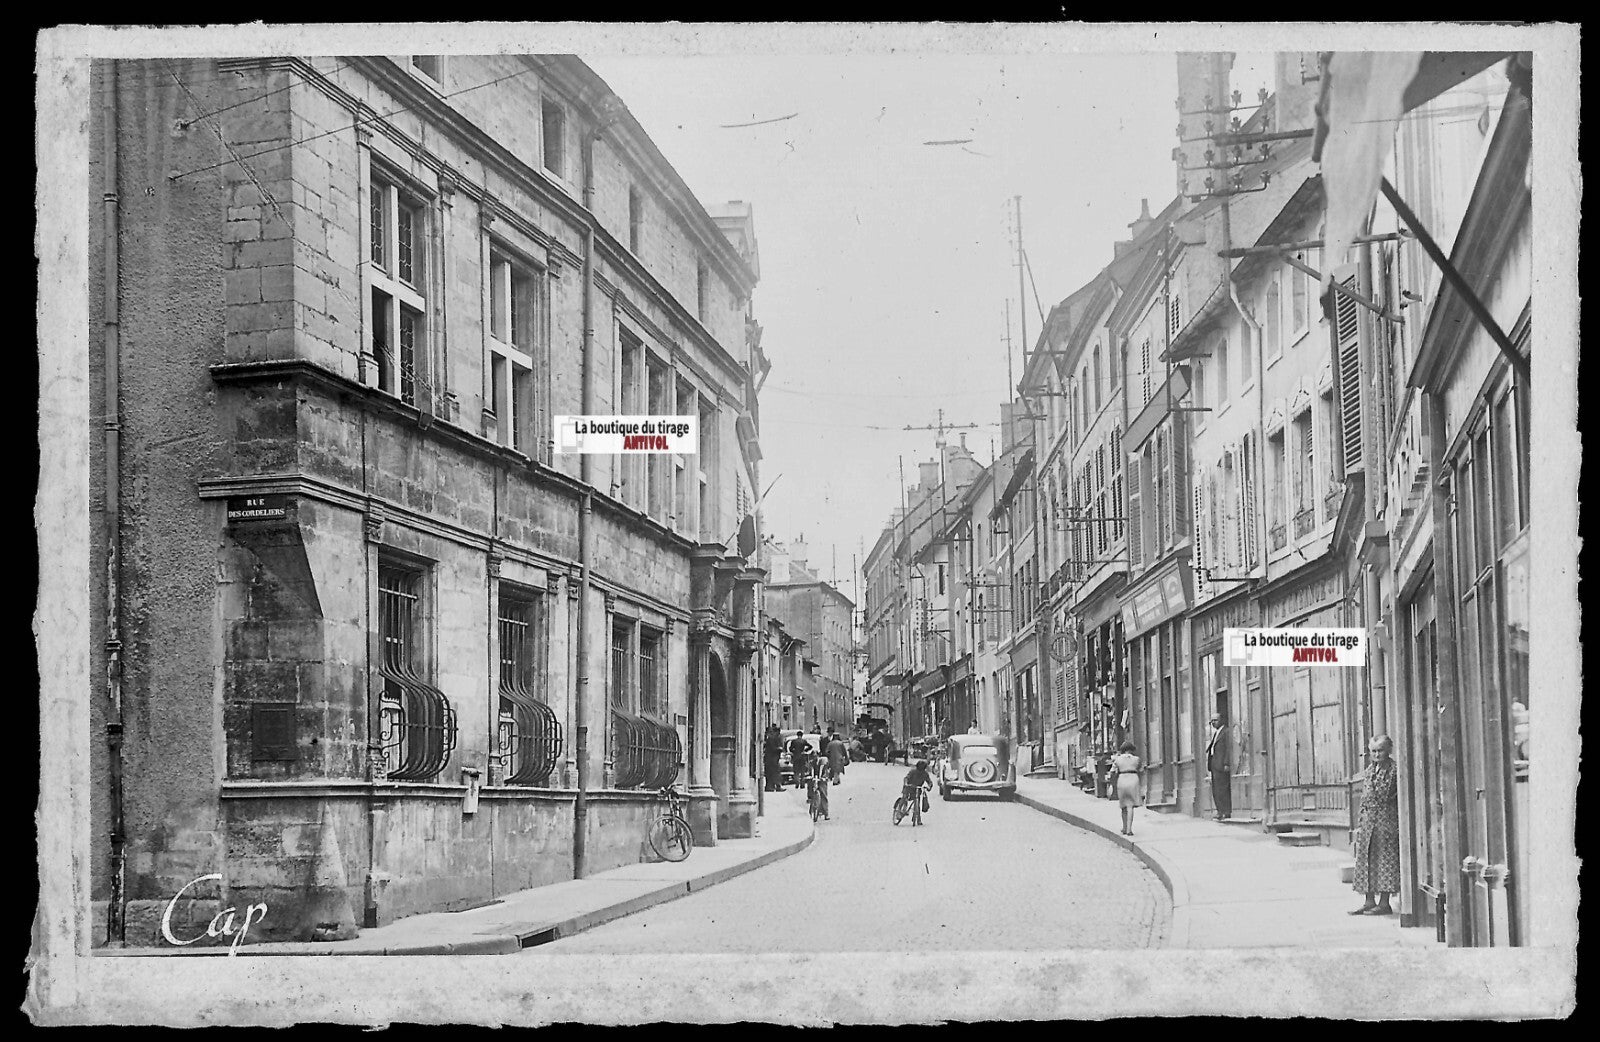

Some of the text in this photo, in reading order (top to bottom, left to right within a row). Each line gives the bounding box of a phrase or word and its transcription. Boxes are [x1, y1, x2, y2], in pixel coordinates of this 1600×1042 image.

[247, 498, 265, 506] RUE
[228, 508, 285, 518] DES CORDELIERS
